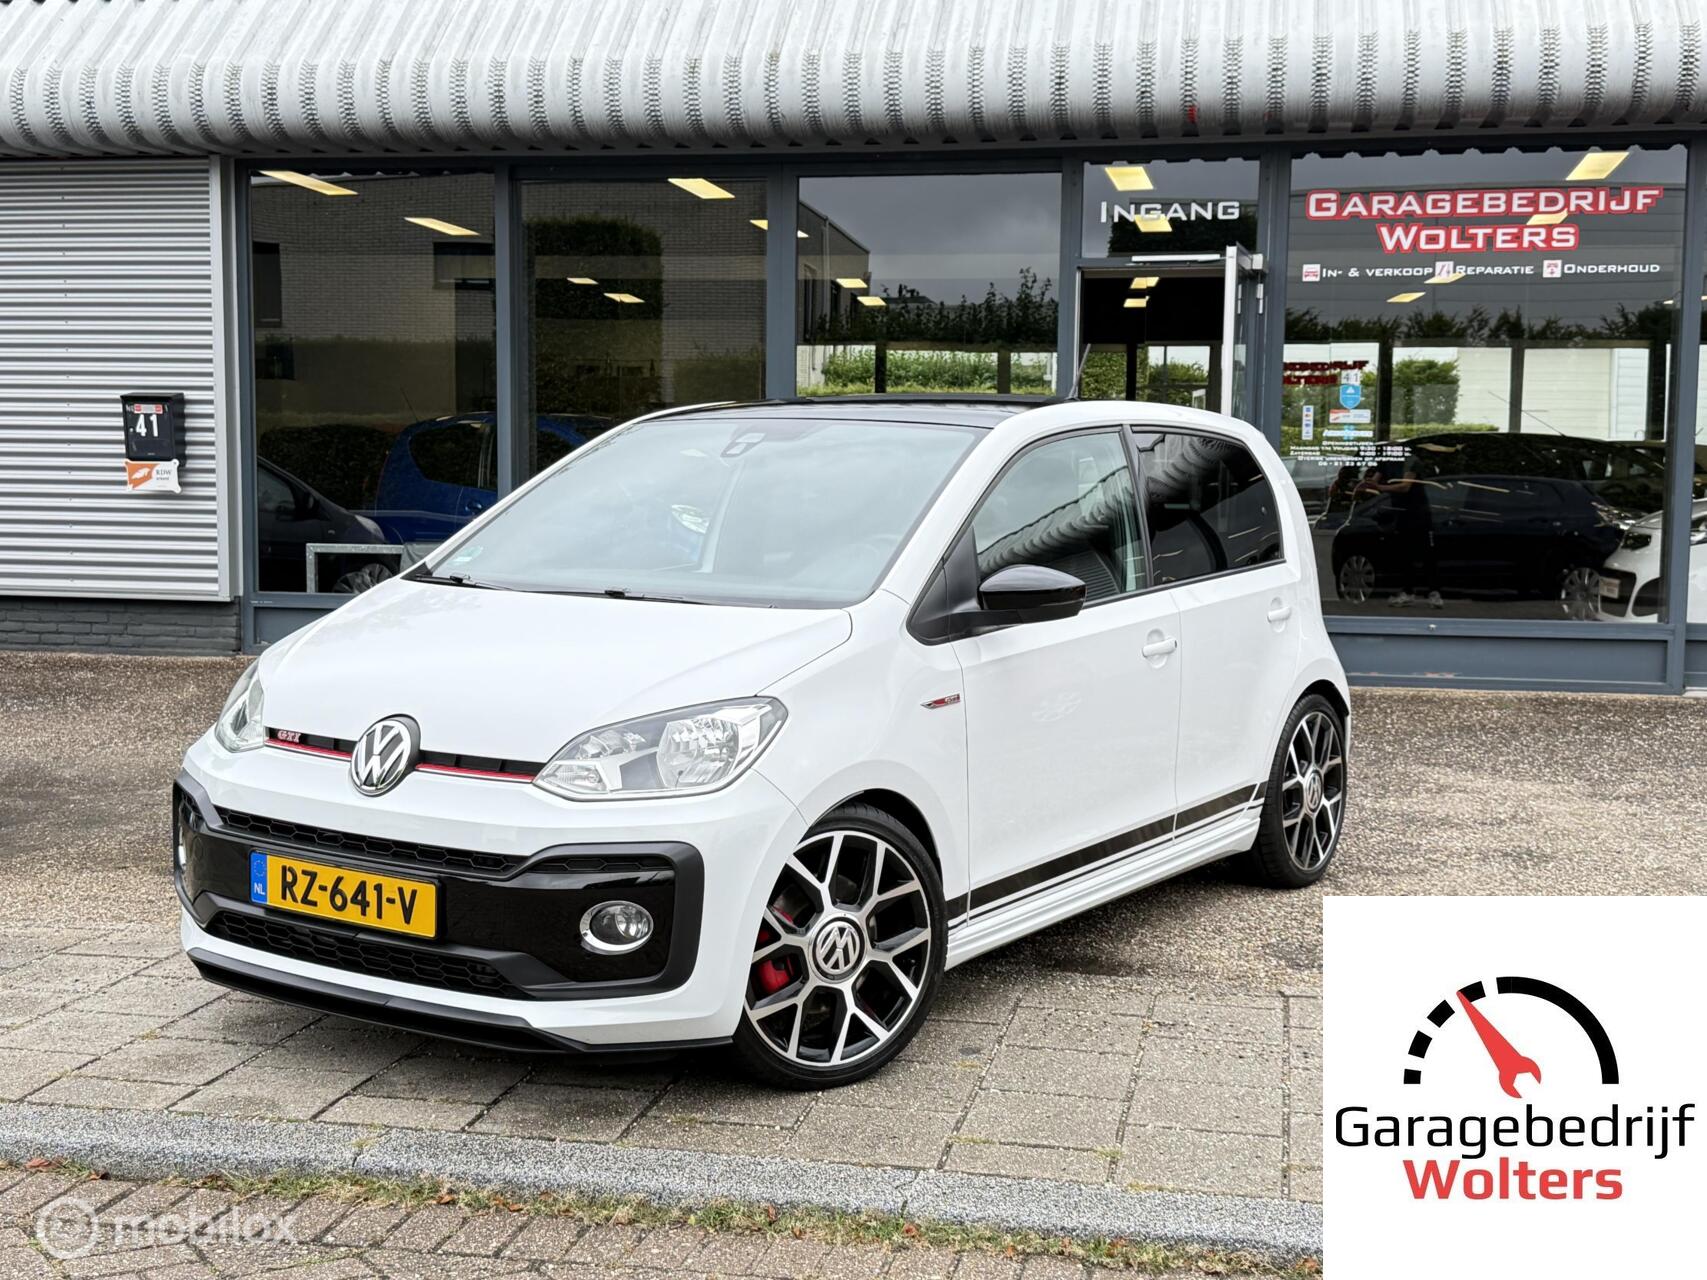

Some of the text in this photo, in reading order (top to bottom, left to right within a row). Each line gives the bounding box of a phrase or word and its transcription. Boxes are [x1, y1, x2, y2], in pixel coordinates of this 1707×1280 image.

[1307, 188, 1662, 219] GARAGEBEDRIJF
[1100, 201, 1240, 222] INGANG
[1378, 224, 1577, 252] WOLTERS
[1365, 267, 1434, 276] VERKOOP
[1455, 265, 1534, 275] REPARATIE
[1563, 263, 1661, 274] ONDERHOUD
[1343, 373, 1359, 382] 41
[136, 414, 159, 437] 41
[277, 730, 301, 743] GTI
[253, 883, 266, 896] NL
[280, 864, 418, 925] RZ-641-V
